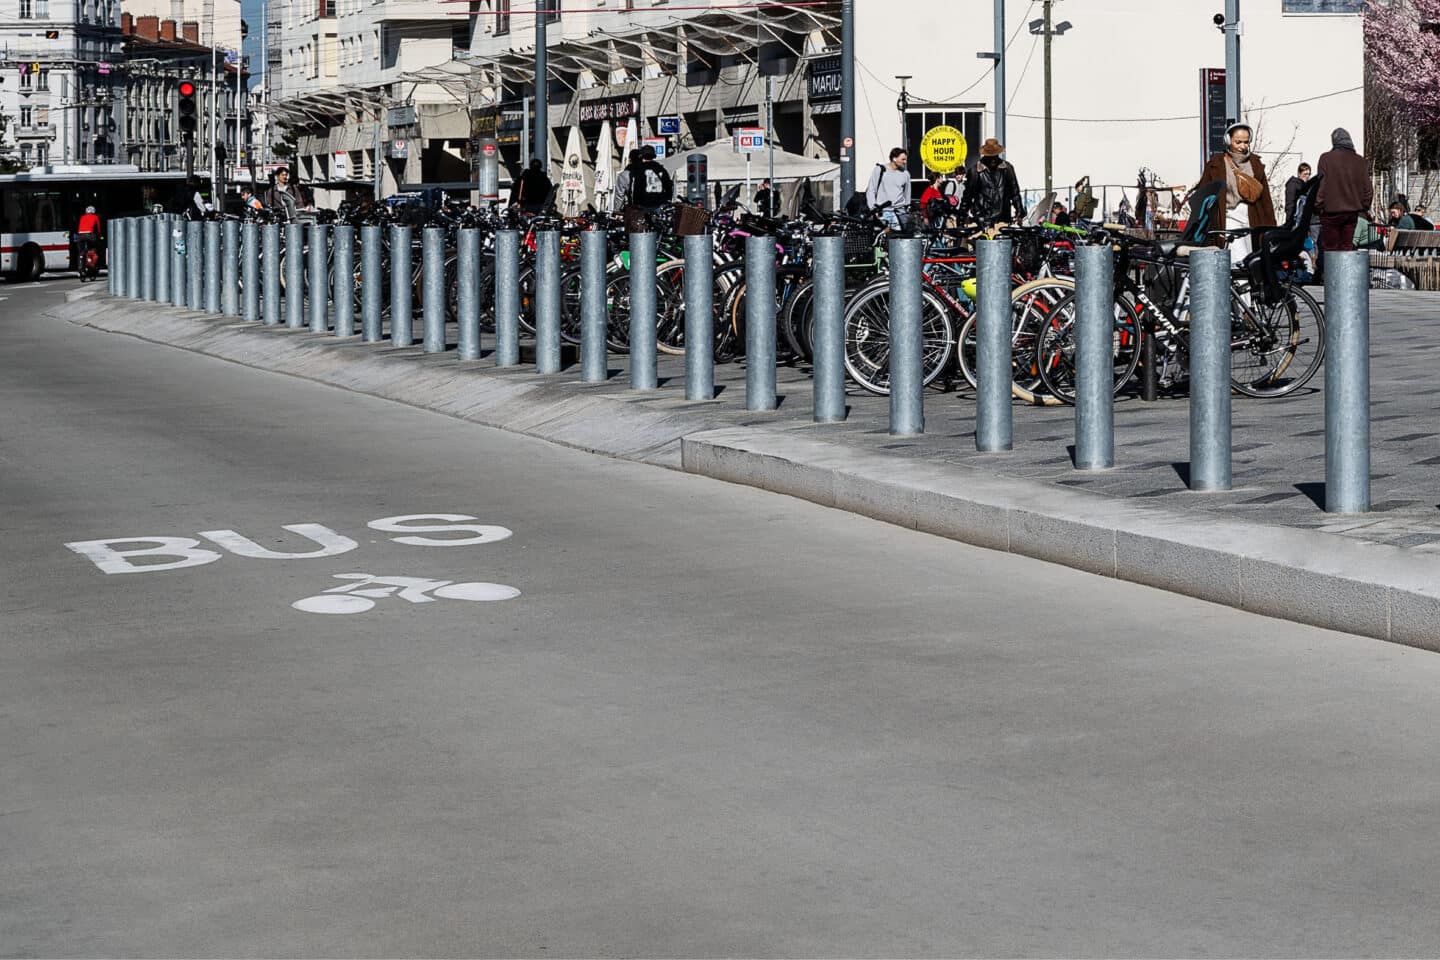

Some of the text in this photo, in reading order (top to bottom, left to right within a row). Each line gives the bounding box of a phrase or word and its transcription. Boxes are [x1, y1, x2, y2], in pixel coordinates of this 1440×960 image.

[812, 73, 842, 94] MARIU
[931, 138, 956, 146] HAPPY
[933, 147, 955, 155] HOUR
[1137, 293, 1179, 335] BTWIN
[64, 513, 514, 575] BUS
